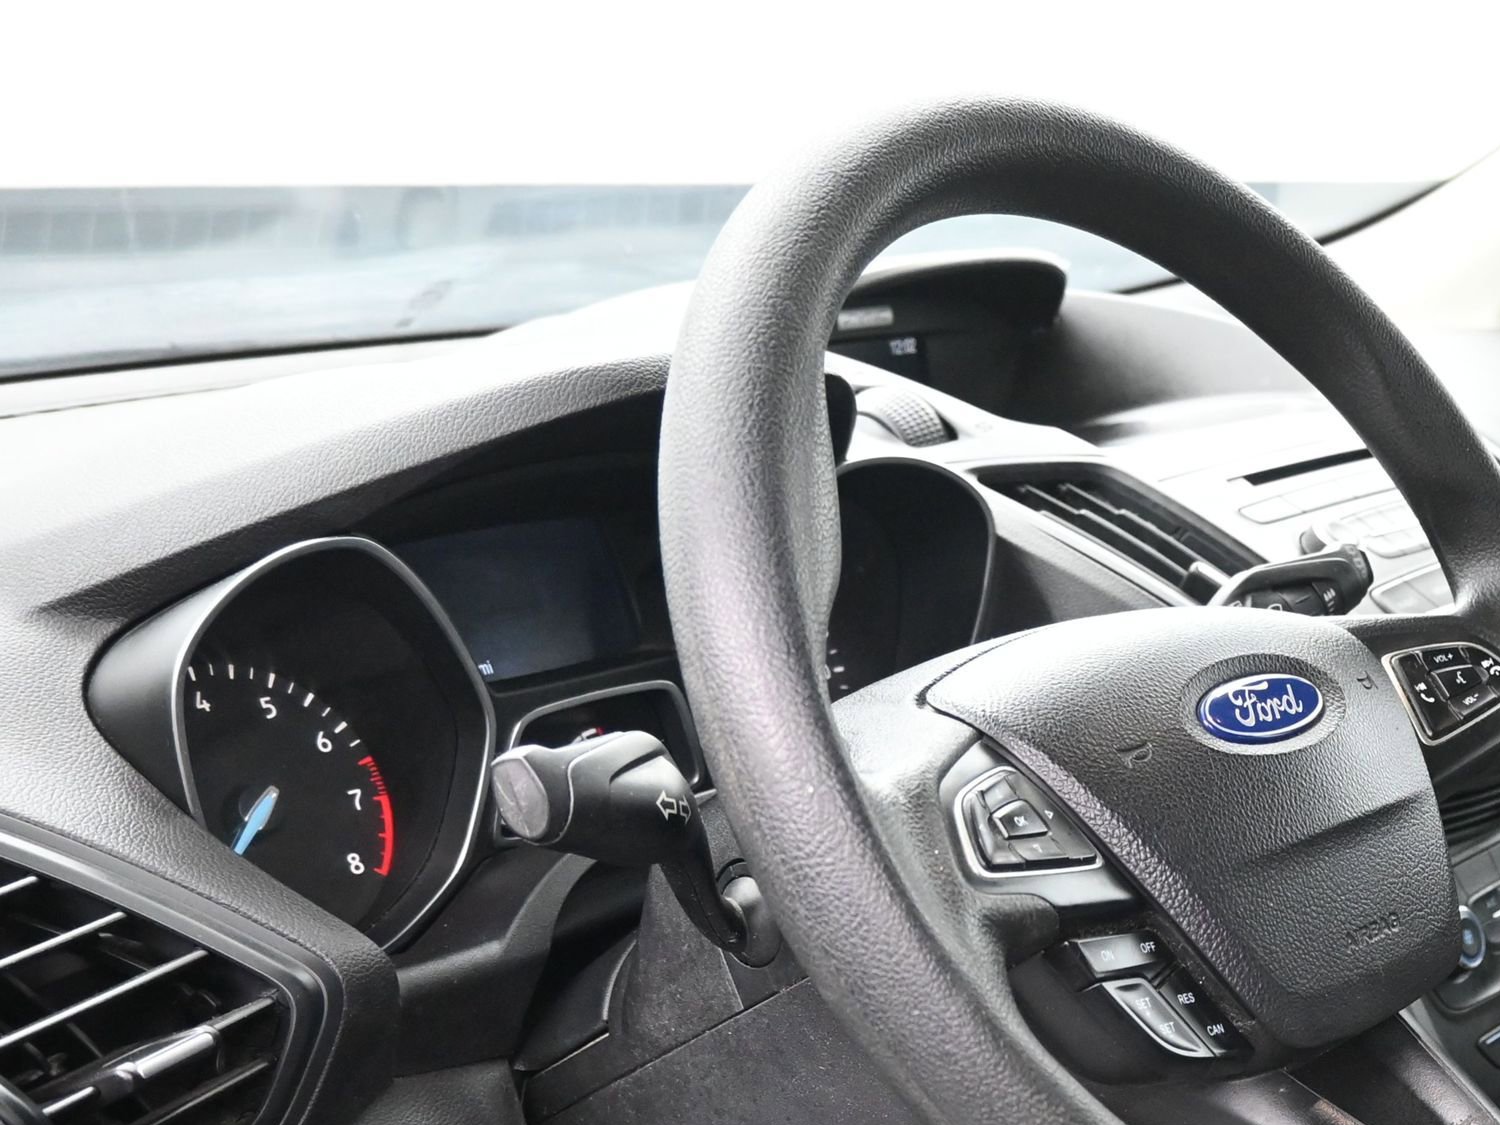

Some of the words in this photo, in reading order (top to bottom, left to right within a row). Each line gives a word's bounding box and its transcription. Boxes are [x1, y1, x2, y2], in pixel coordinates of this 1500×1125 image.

[195, 690, 212, 712] 4
[259, 696, 278, 720] 5
[1227, 680, 1303, 727] Ford
[316, 730, 333, 753] 6
[346, 788, 362, 811] 7
[346, 852, 366, 876] 8
[1101, 949, 1115, 962] ON
[1139, 941, 1157, 954] OFF
[1177, 992, 1196, 1005] RES
[1206, 1023, 1226, 1036] CAN
